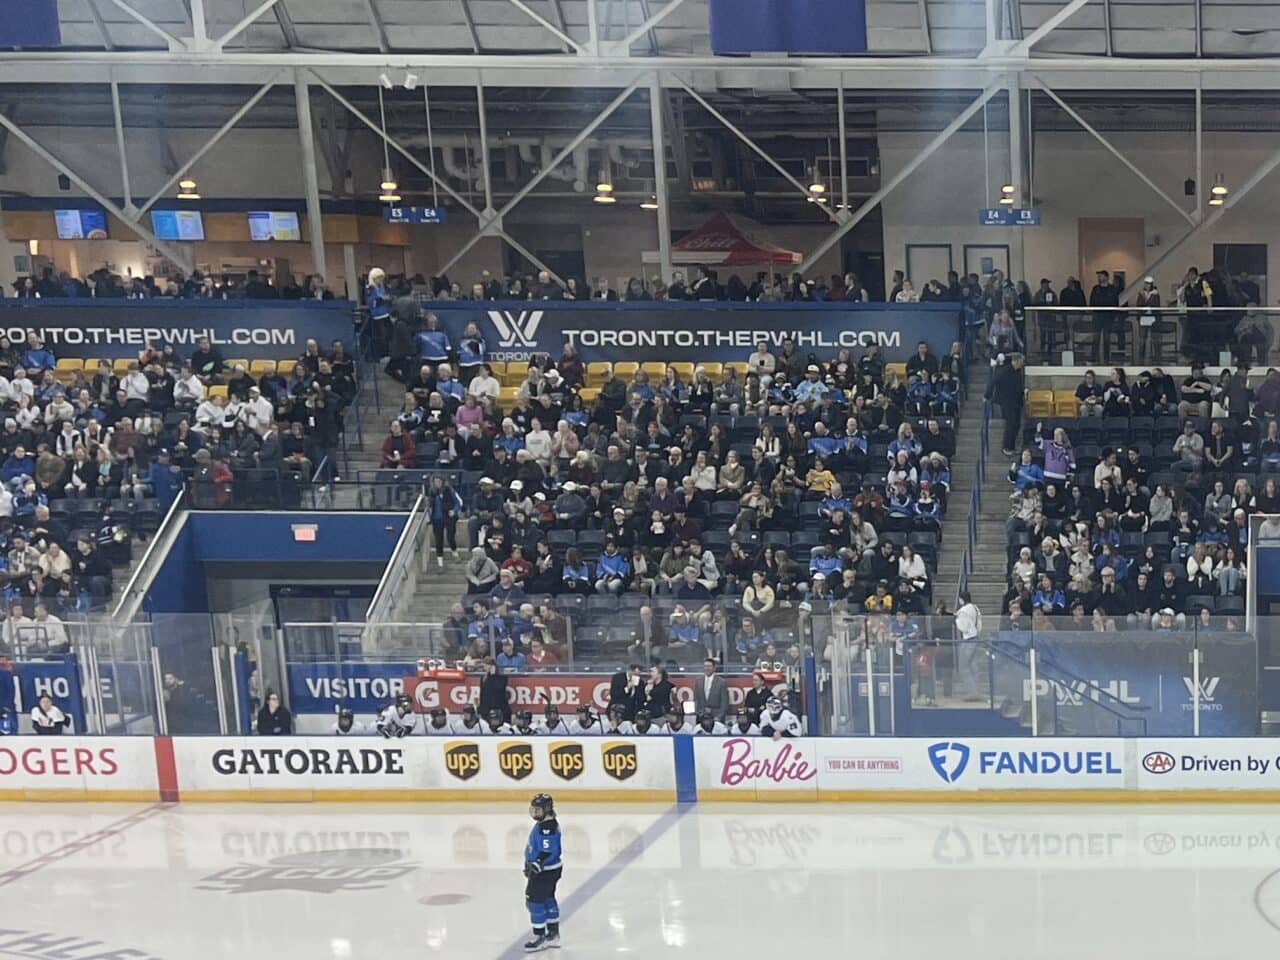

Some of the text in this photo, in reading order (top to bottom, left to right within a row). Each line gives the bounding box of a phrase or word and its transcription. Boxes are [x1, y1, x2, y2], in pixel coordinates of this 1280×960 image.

[0, 327, 295, 345] ONTO.THEPWHL.COM
[34, 677, 113, 698] HOE
[451, 686, 580, 705] GAORADE
[212, 749, 404, 775] GATORADE
[446, 751, 480, 777] ups
[501, 751, 533, 777] ups
[551, 751, 583, 777] ups
[603, 751, 637, 777] ups
[720, 738, 818, 786] Barbie
[979, 751, 1122, 775] FANDUEL
[1146, 752, 1172, 770] CAA
[1181, 755, 1241, 771] Driven
[1248, 755, 1270, 774] by
